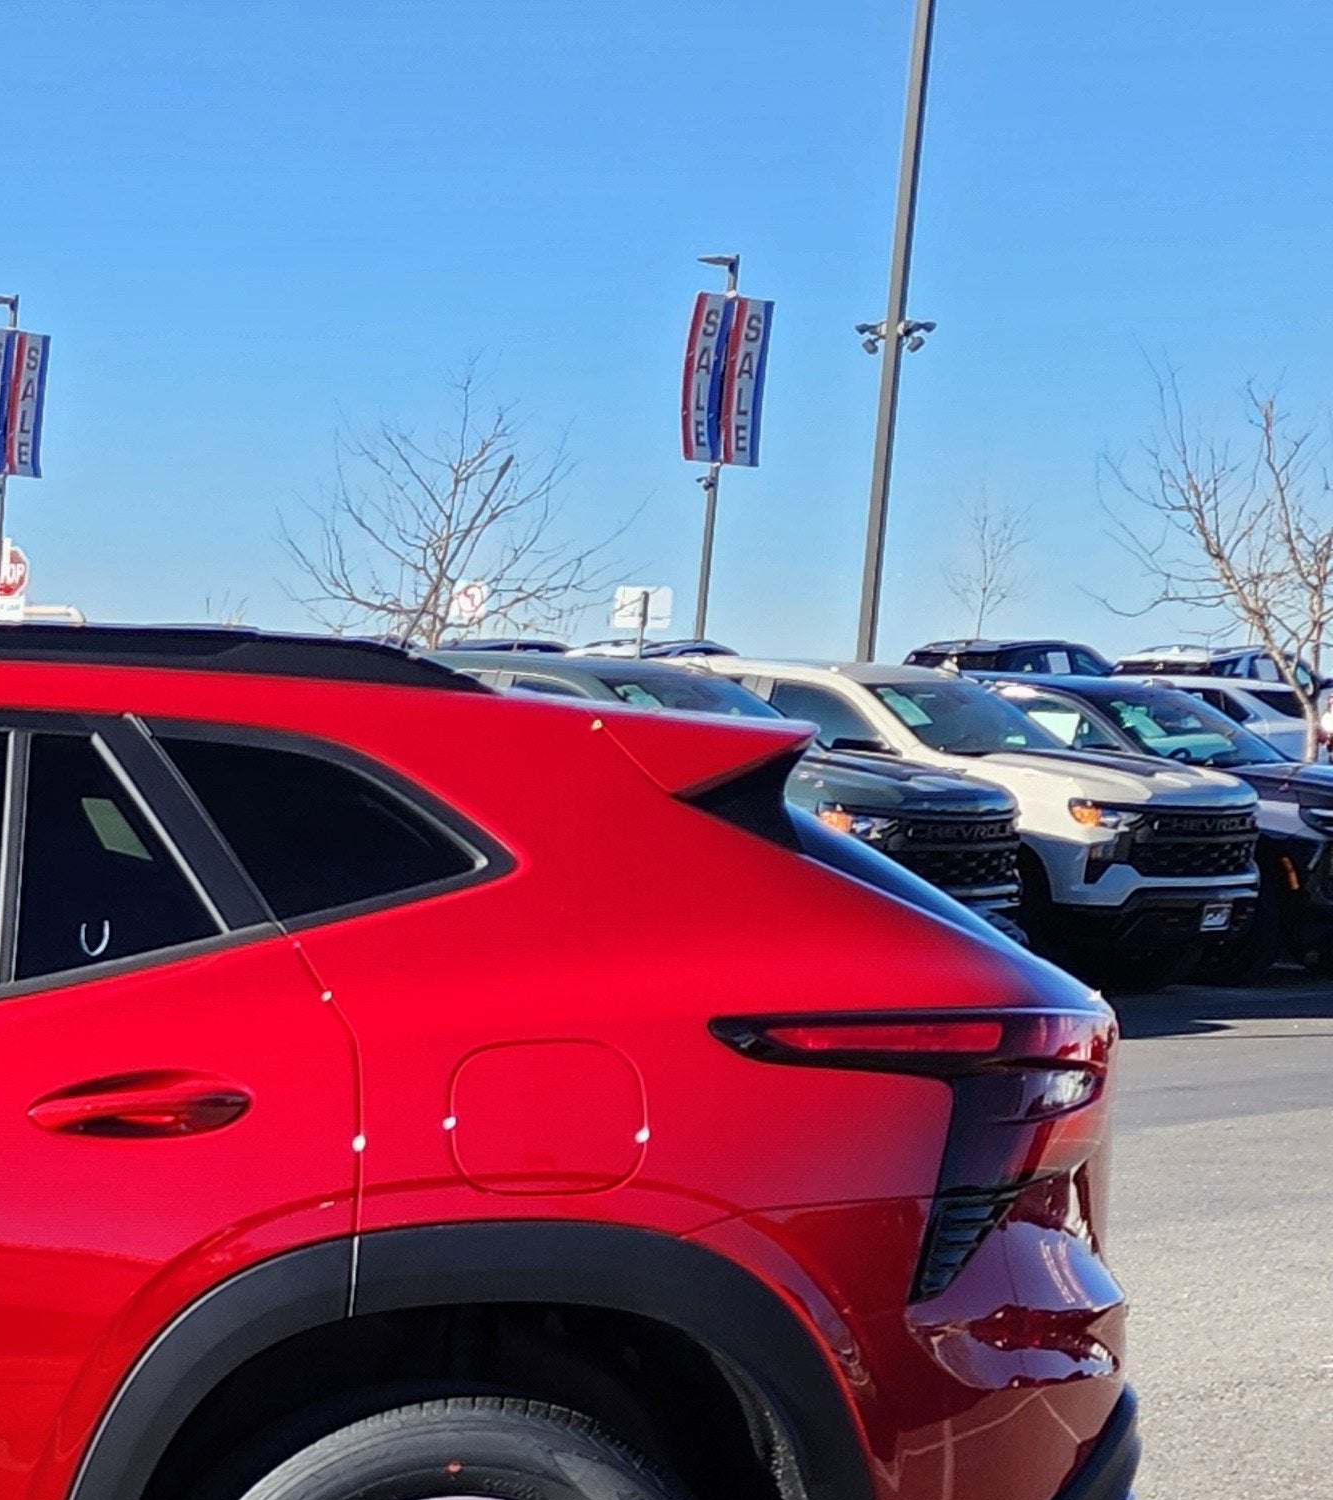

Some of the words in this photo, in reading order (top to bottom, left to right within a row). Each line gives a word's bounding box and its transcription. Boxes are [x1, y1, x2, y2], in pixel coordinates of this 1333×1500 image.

[19, 345, 39, 464] SALE
[694, 309, 720, 447] SALE
[735, 314, 763, 452] SALE
